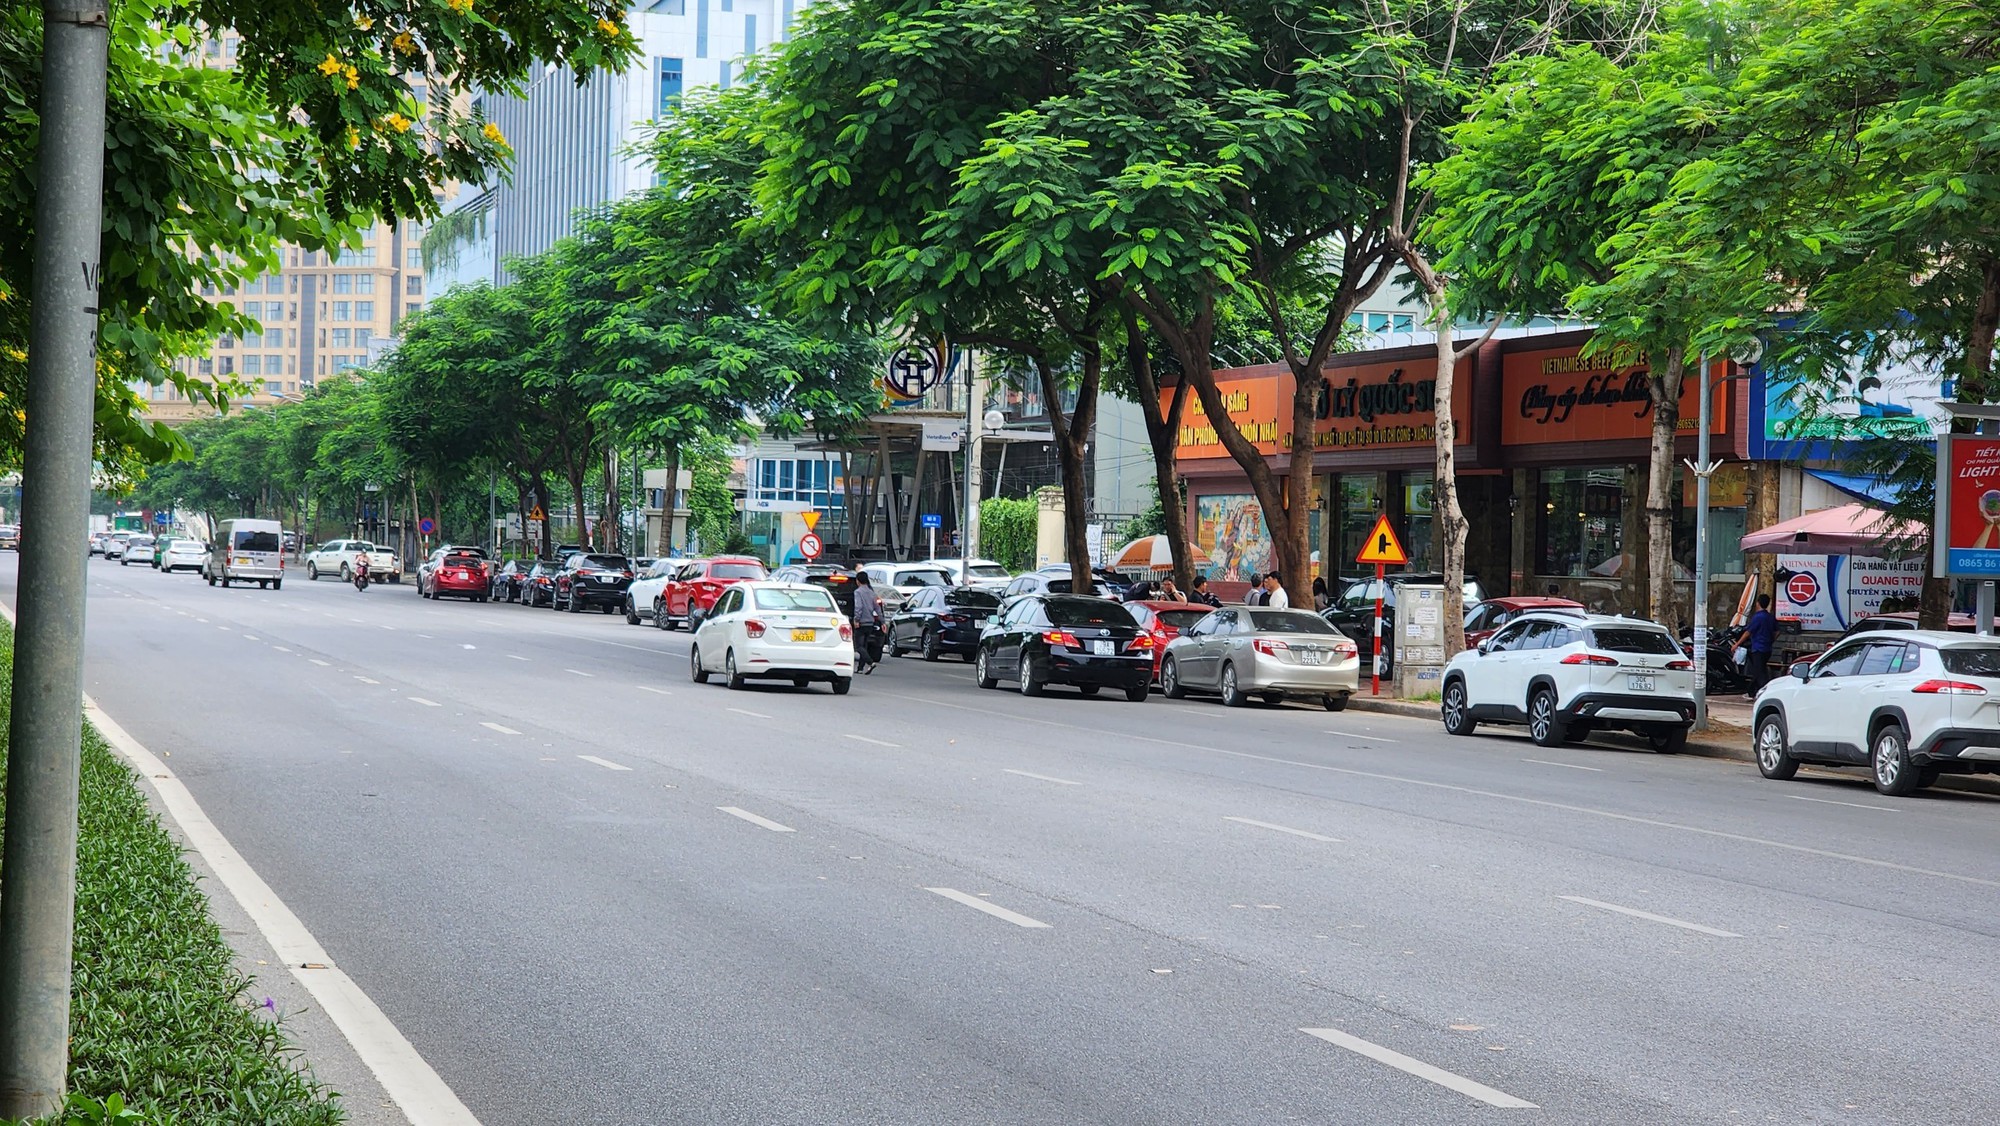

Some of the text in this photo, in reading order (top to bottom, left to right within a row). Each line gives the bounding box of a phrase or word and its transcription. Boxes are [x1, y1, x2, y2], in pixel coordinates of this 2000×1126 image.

[1541, 356, 1589, 375] VIETNAMESE
[1591, 353, 1610, 370] BEEF
[1333, 379, 1359, 418] LÝ
[1360, 368, 1415, 422] QUỐC
[1228, 390, 1249, 413] SÁNG
[1959, 466, 1998, 478] LIGHT
[1853, 560, 1866, 571] CỬA
[1869, 561, 1888, 571] HÀNG
[1890, 560, 1903, 573] VẬT
[1904, 562, 1919, 573] LIỆU
[1959, 558, 1997, 567] 0865 86
[1862, 576, 1900, 586] QUANG
[1847, 588, 1879, 596] CHUYÊN
[1864, 599, 1881, 607] CÁT
